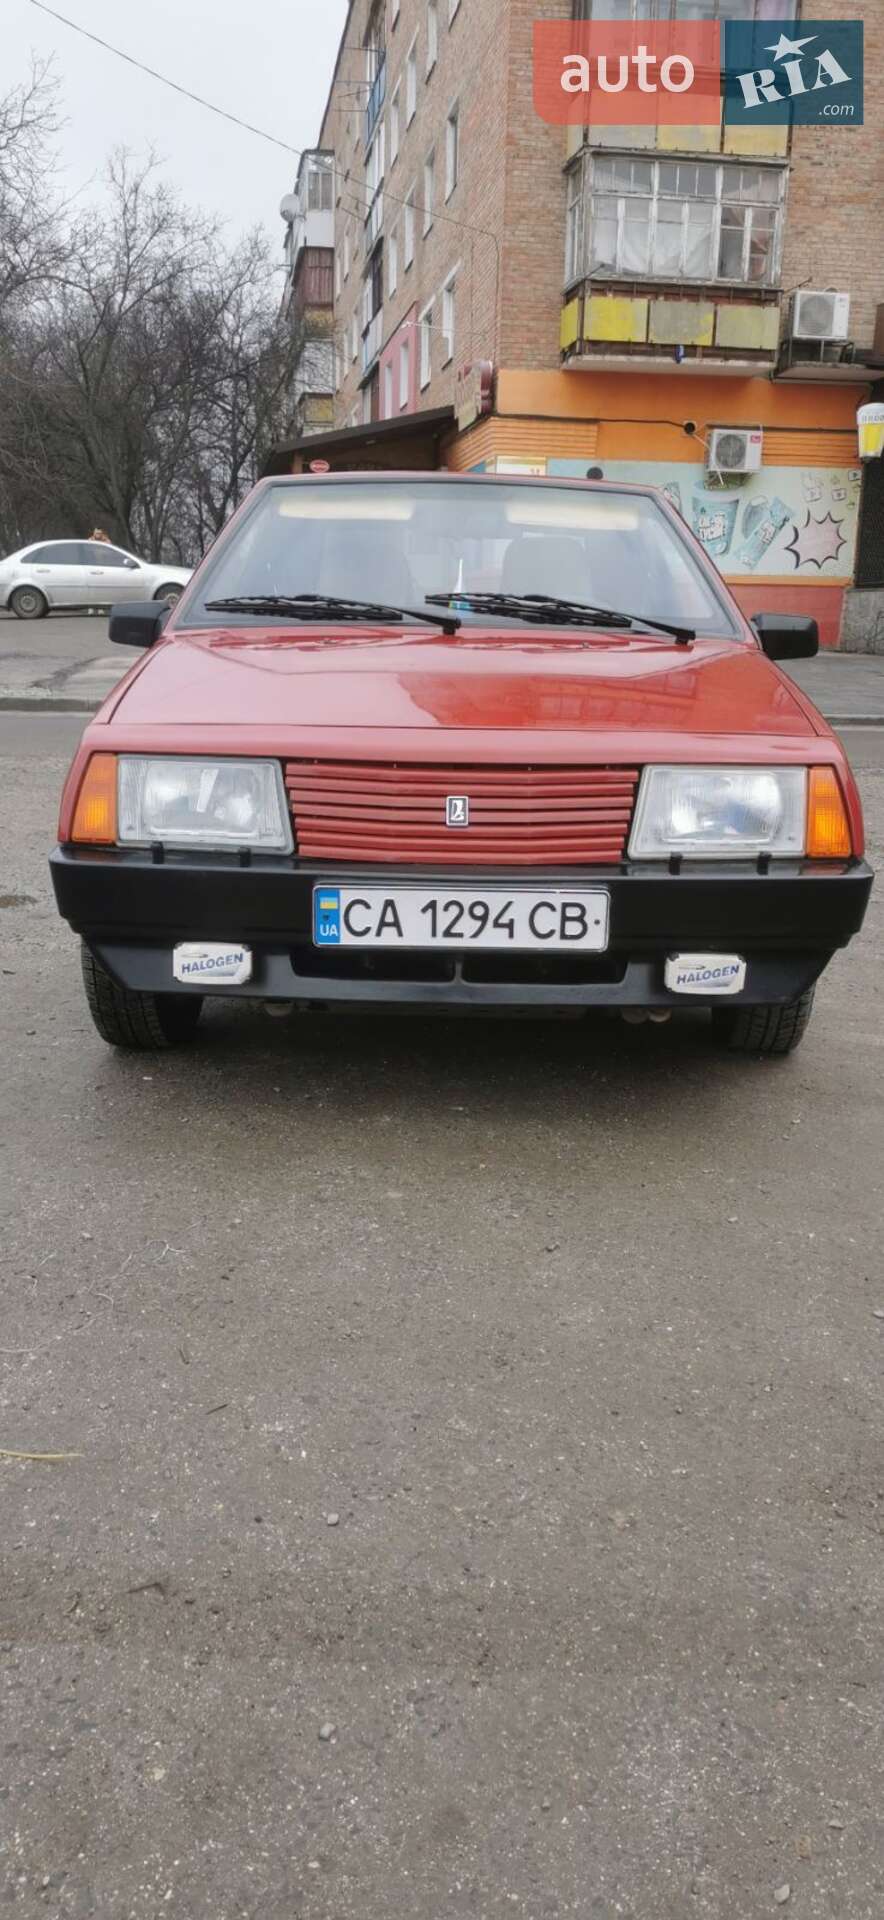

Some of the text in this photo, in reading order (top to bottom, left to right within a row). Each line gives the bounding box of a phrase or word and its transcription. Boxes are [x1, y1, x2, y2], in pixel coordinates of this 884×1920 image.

[343, 898, 588, 940] CA 1294 CB
[320, 924, 339, 937] UA
[181, 952, 244, 974] HALOGEN
[676, 964, 739, 985] HALOGEN
